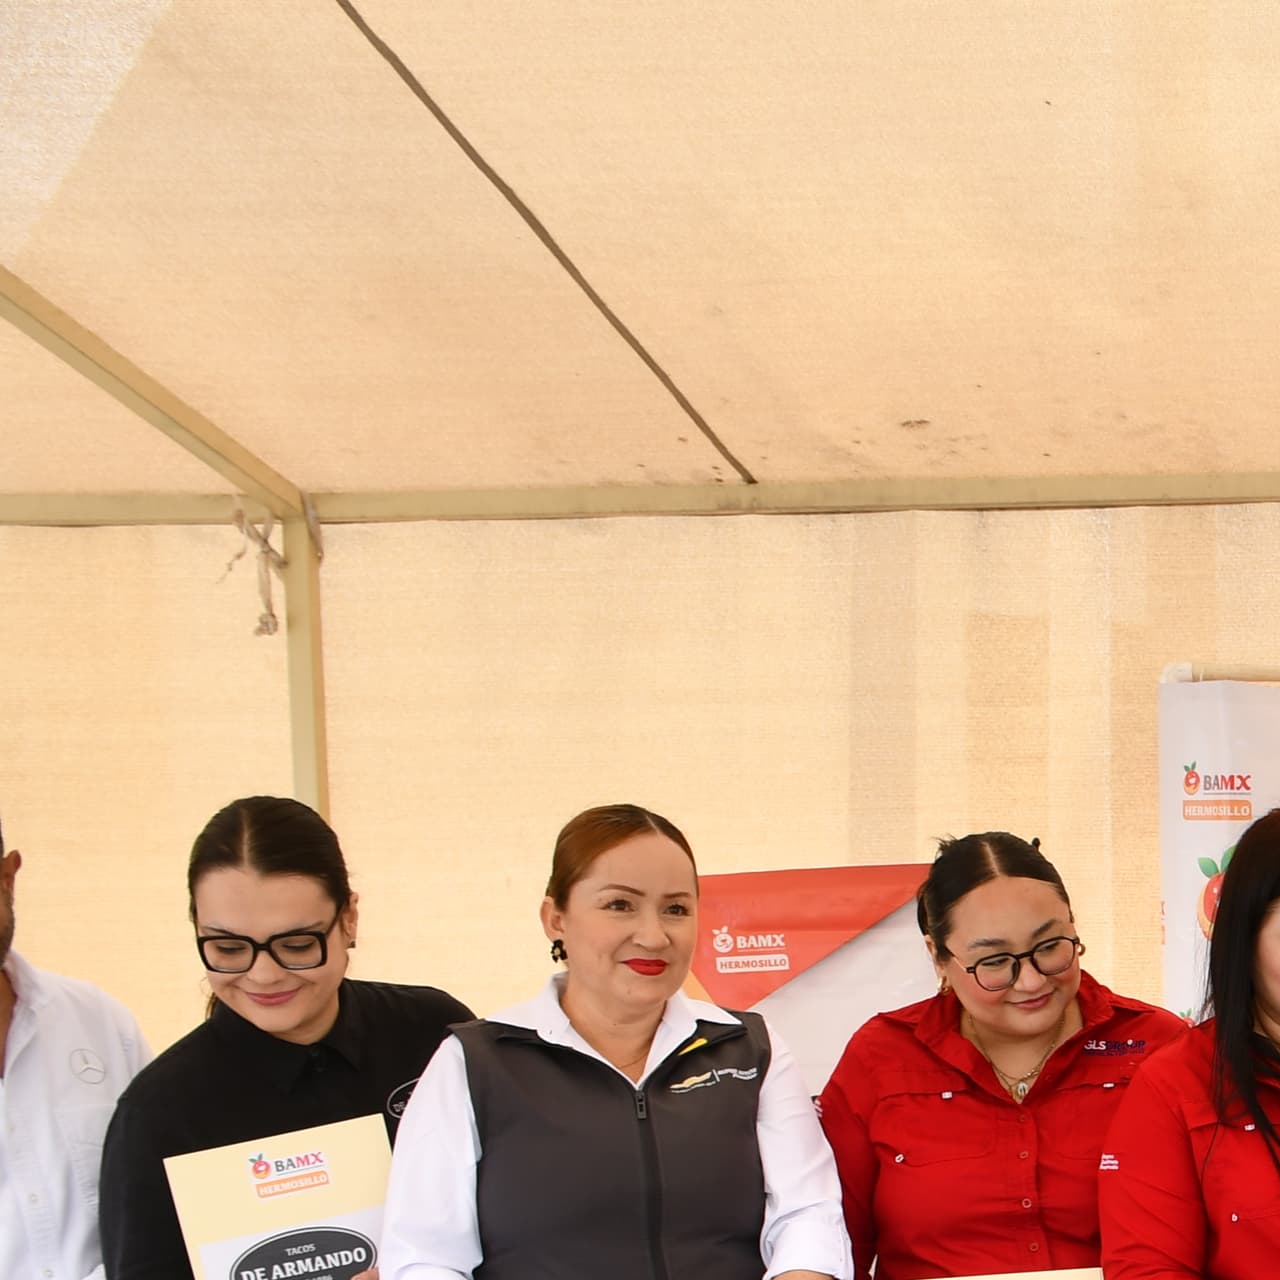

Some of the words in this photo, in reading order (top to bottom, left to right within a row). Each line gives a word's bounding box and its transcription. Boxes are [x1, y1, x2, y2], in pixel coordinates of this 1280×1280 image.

[1203, 774, 1251, 791] BAMX
[1184, 804, 1250, 817] HERMOSILLO
[736, 933, 785, 949] BAMX
[720, 958, 787, 969] HERMOSILLO
[274, 1151, 324, 1173] BAMX
[259, 1174, 328, 1196] HERMOSILLO
[284, 1243, 316, 1257] TACOS
[271, 1246, 368, 1280] ARMANDO
